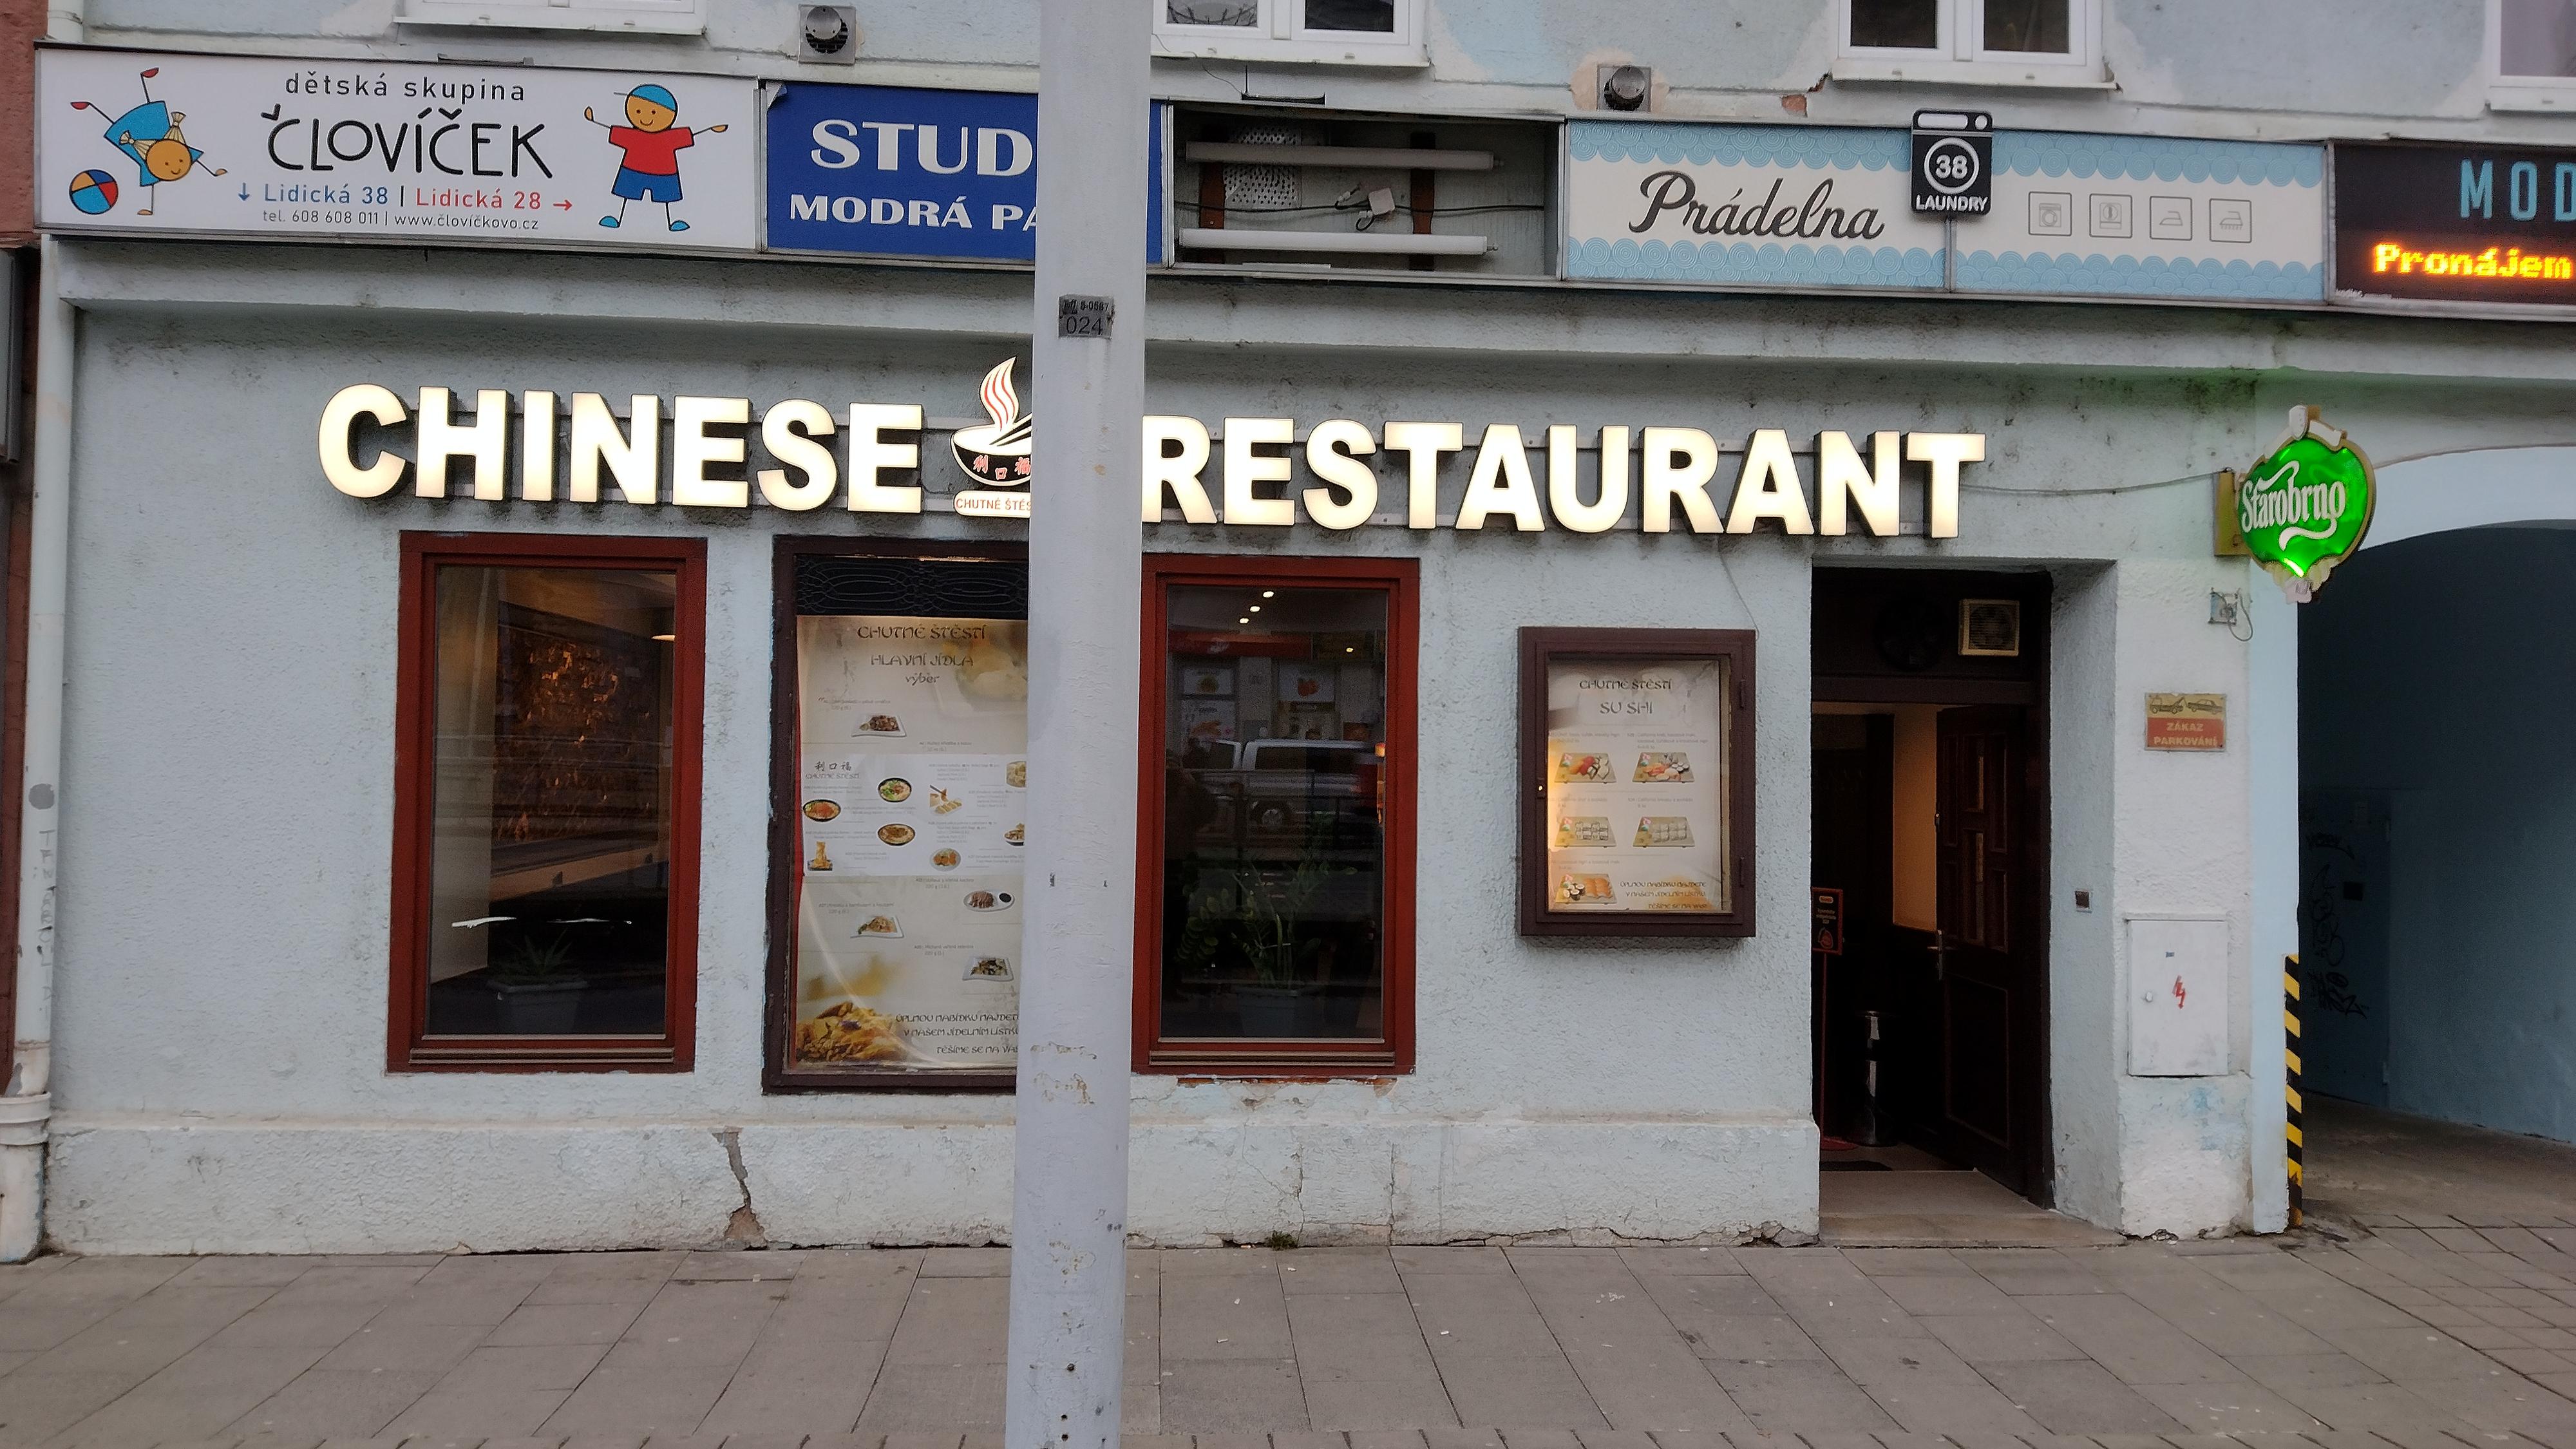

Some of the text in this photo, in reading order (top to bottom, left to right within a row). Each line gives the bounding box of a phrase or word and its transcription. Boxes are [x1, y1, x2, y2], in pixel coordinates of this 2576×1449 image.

[285, 71, 525, 104] dětská skupina
[261, 104, 553, 178] ČLOVÍČEK
[1935, 155, 1968, 179] 38
[264, 184, 389, 205] Lidická 38
[416, 188, 542, 210] Lidická 28
[2460, 158, 2576, 222] MOD
[791, 194, 972, 229] MODRÁ
[1629, 170, 1884, 240] Prádelna
[1916, 194, 1989, 211] LAUNDRY
[263, 211, 379, 225] tel. 608 608 011
[395, 212, 539, 230] www.človíčkovo.cz
[2375, 243, 2571, 278] Pronájem
[1066, 316, 1103, 335] 024
[318, 383, 1986, 539] CHINESE RESTAURANT
[956, 497, 1001, 510] CHUTNÉ
[2242, 460, 2346, 549] Starobrno
[857, 623, 926, 639] CHUTNÉ
[871, 653, 927, 666] HLAVNÍ
[2166, 721, 2204, 732] ZÁKAZ
[2153, 735, 2218, 746] PARKOVÁNÍ
[936, 1013, 978, 1023] NABÍDKU
[971, 1045, 983, 1054] SE
[985, 1045, 999, 1054] NA
